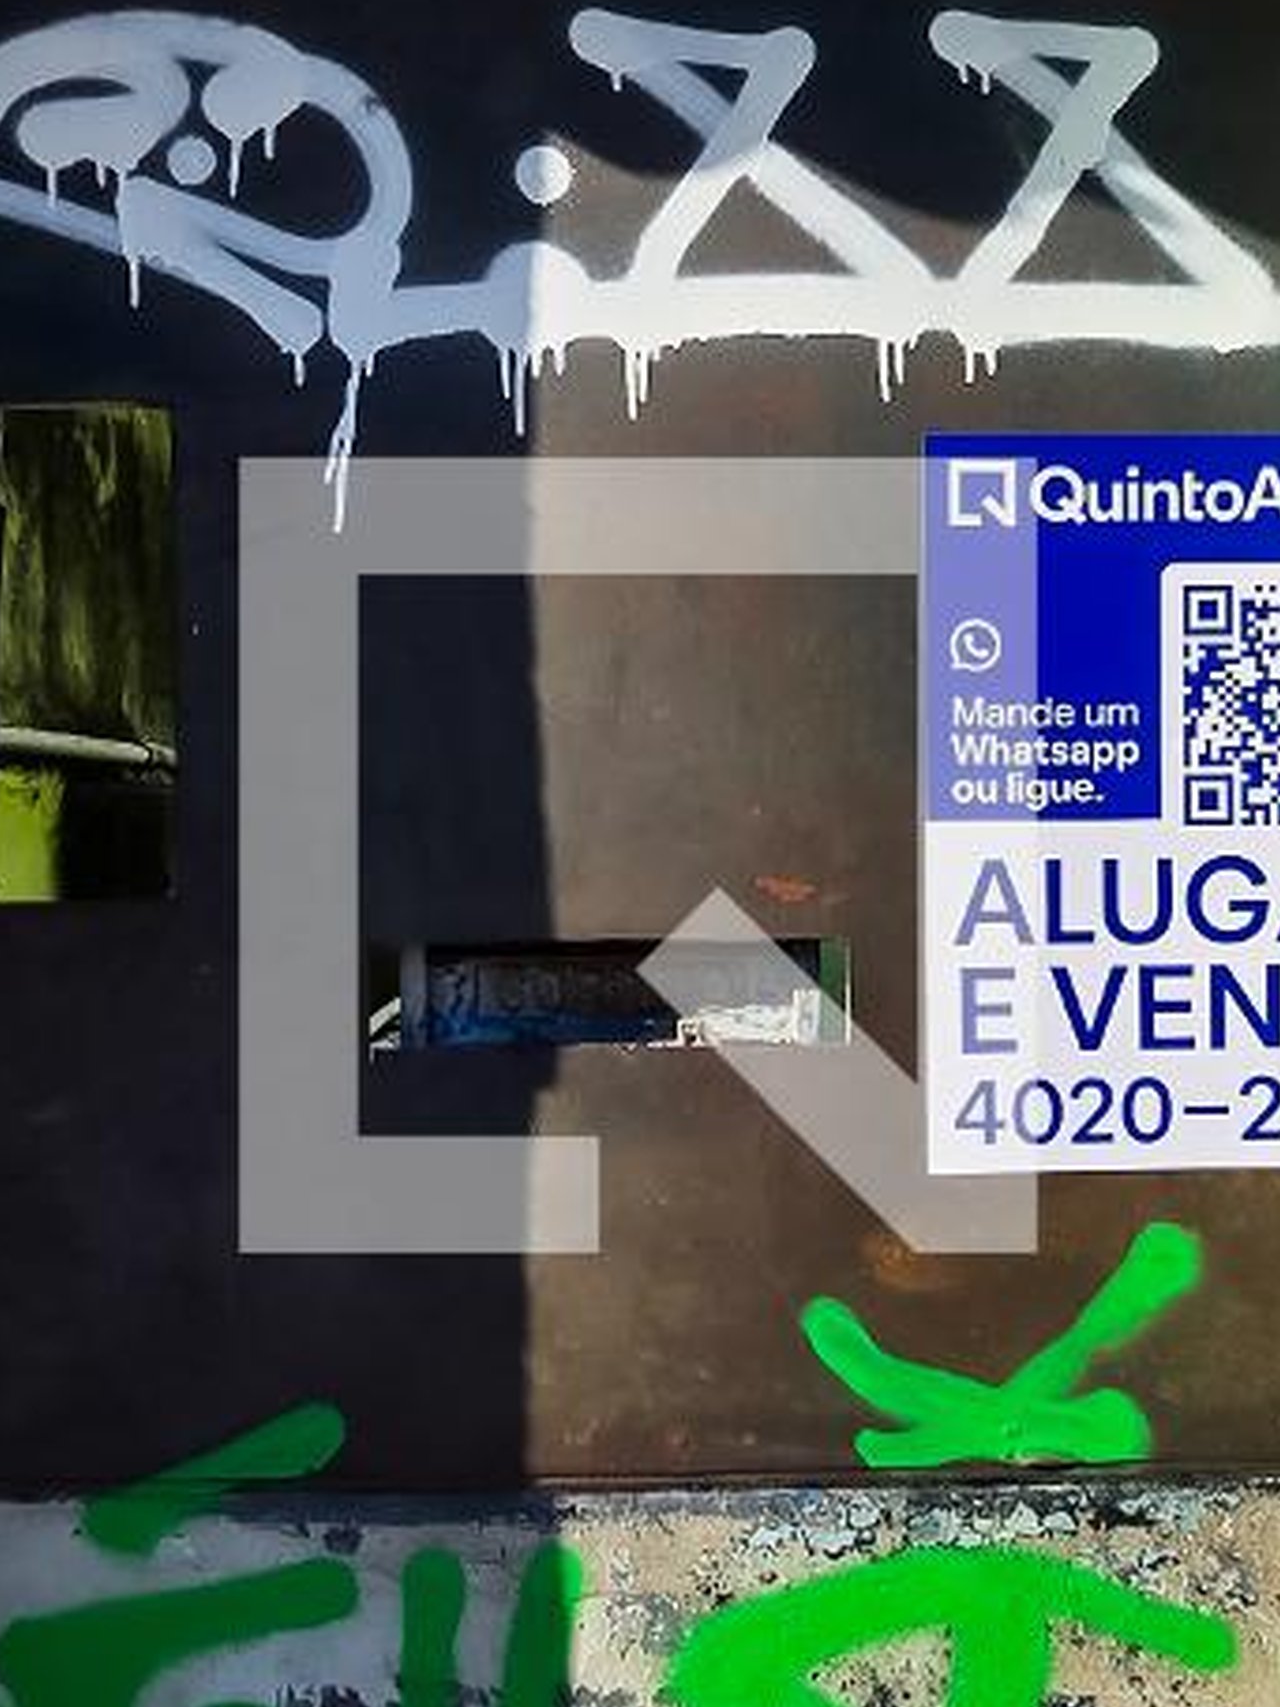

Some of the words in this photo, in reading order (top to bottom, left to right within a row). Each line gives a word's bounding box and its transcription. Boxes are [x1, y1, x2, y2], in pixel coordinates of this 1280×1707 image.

[951, 697, 1076, 728] Mande
[1085, 705, 1140, 728] um
[951, 734, 1140, 772] Whatsapp
[950, 780, 997, 804] ou
[1006, 774, 1105, 810] ligue.
[960, 967, 1017, 1054] E
